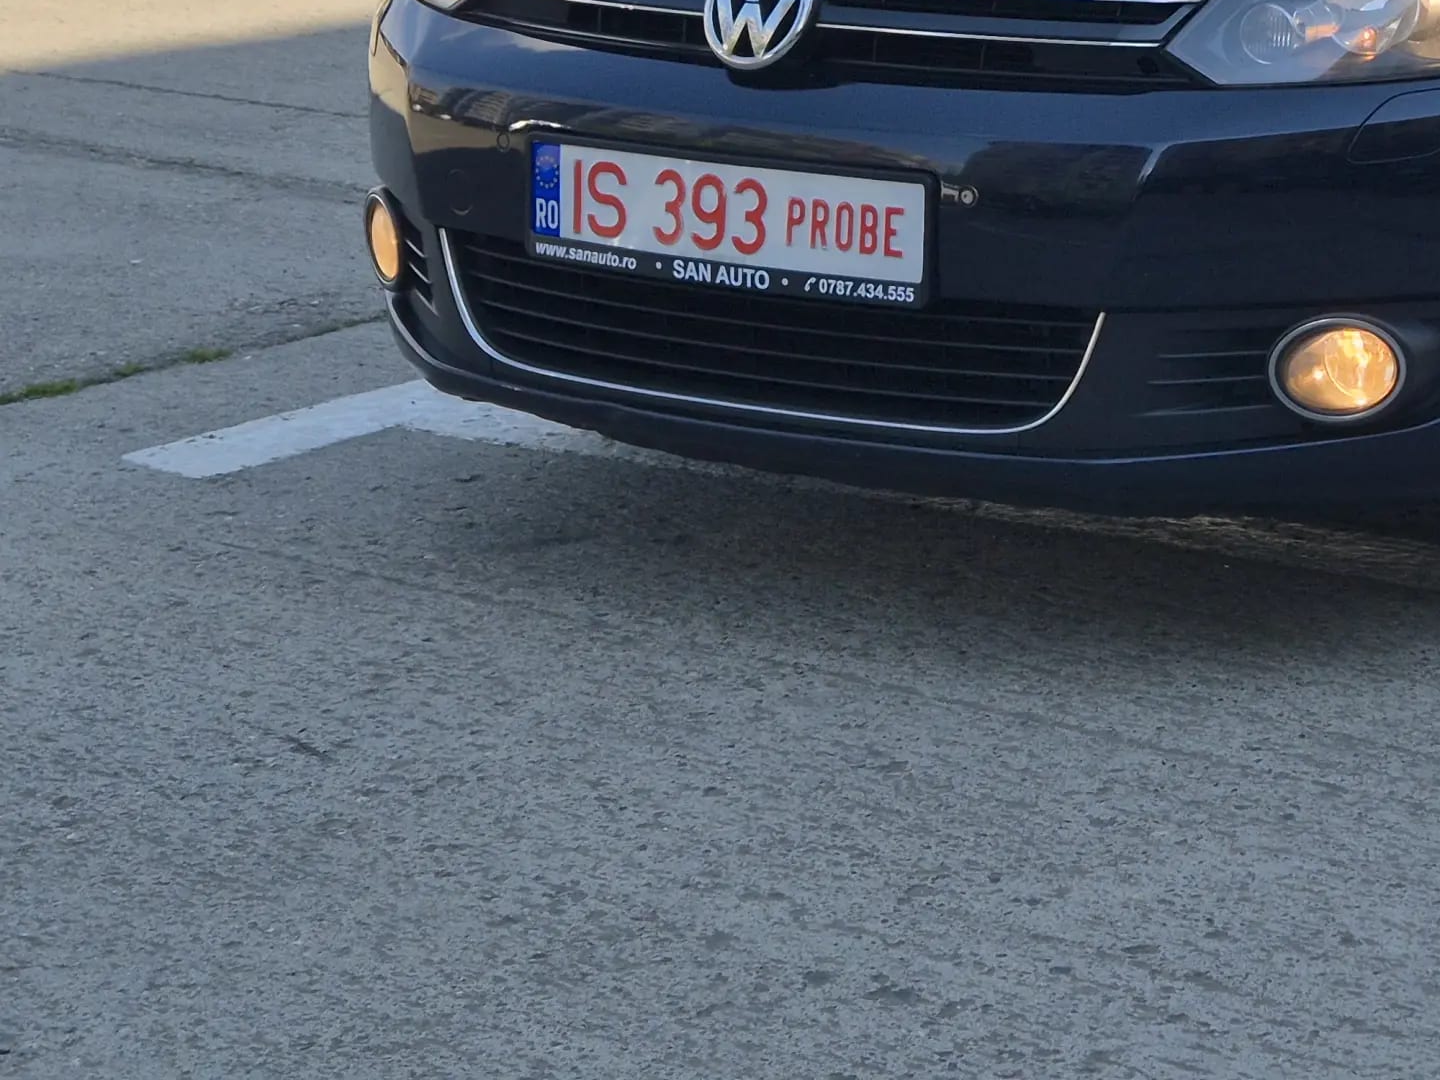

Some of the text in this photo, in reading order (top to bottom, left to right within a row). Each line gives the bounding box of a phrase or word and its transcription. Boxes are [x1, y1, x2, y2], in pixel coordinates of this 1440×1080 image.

[536, 199, 559, 230] RO
[573, 159, 905, 258] IS 393 PROBE
[535, 241, 915, 302] www.sanauto.ro SAN AUTO 0787.434.555
